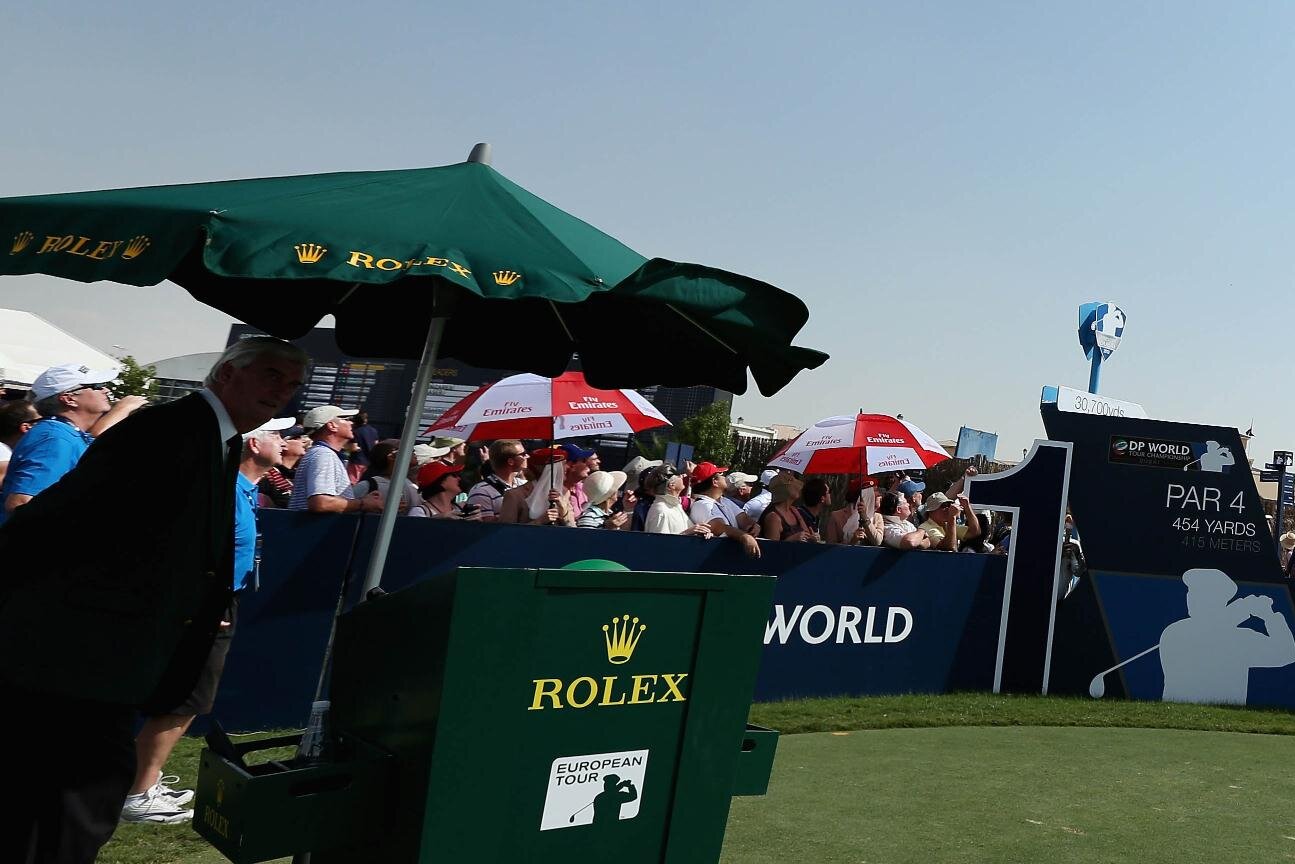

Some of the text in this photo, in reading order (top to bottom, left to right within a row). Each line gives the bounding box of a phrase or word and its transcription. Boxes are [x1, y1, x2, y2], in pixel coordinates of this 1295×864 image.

[346, 250, 472, 279] ROLEX
[483, 405, 533, 417] Emirates
[568, 401, 618, 410] Emirates
[805, 438, 843, 447] Emirates
[1129, 440, 1190, 456] DP WORLD
[1147, 452, 1191, 462] CHAMPIONSHIP
[1165, 483, 1246, 514] PAR 4
[1172, 517, 1256, 537] 454 YARDS
[1209, 537, 1262, 553] METERS
[763, 604, 914, 645] WORLD
[527, 673, 689, 711] ROLEX
[556, 756, 643, 774] EUROPEAN
[555, 772, 599, 786] TOUR
